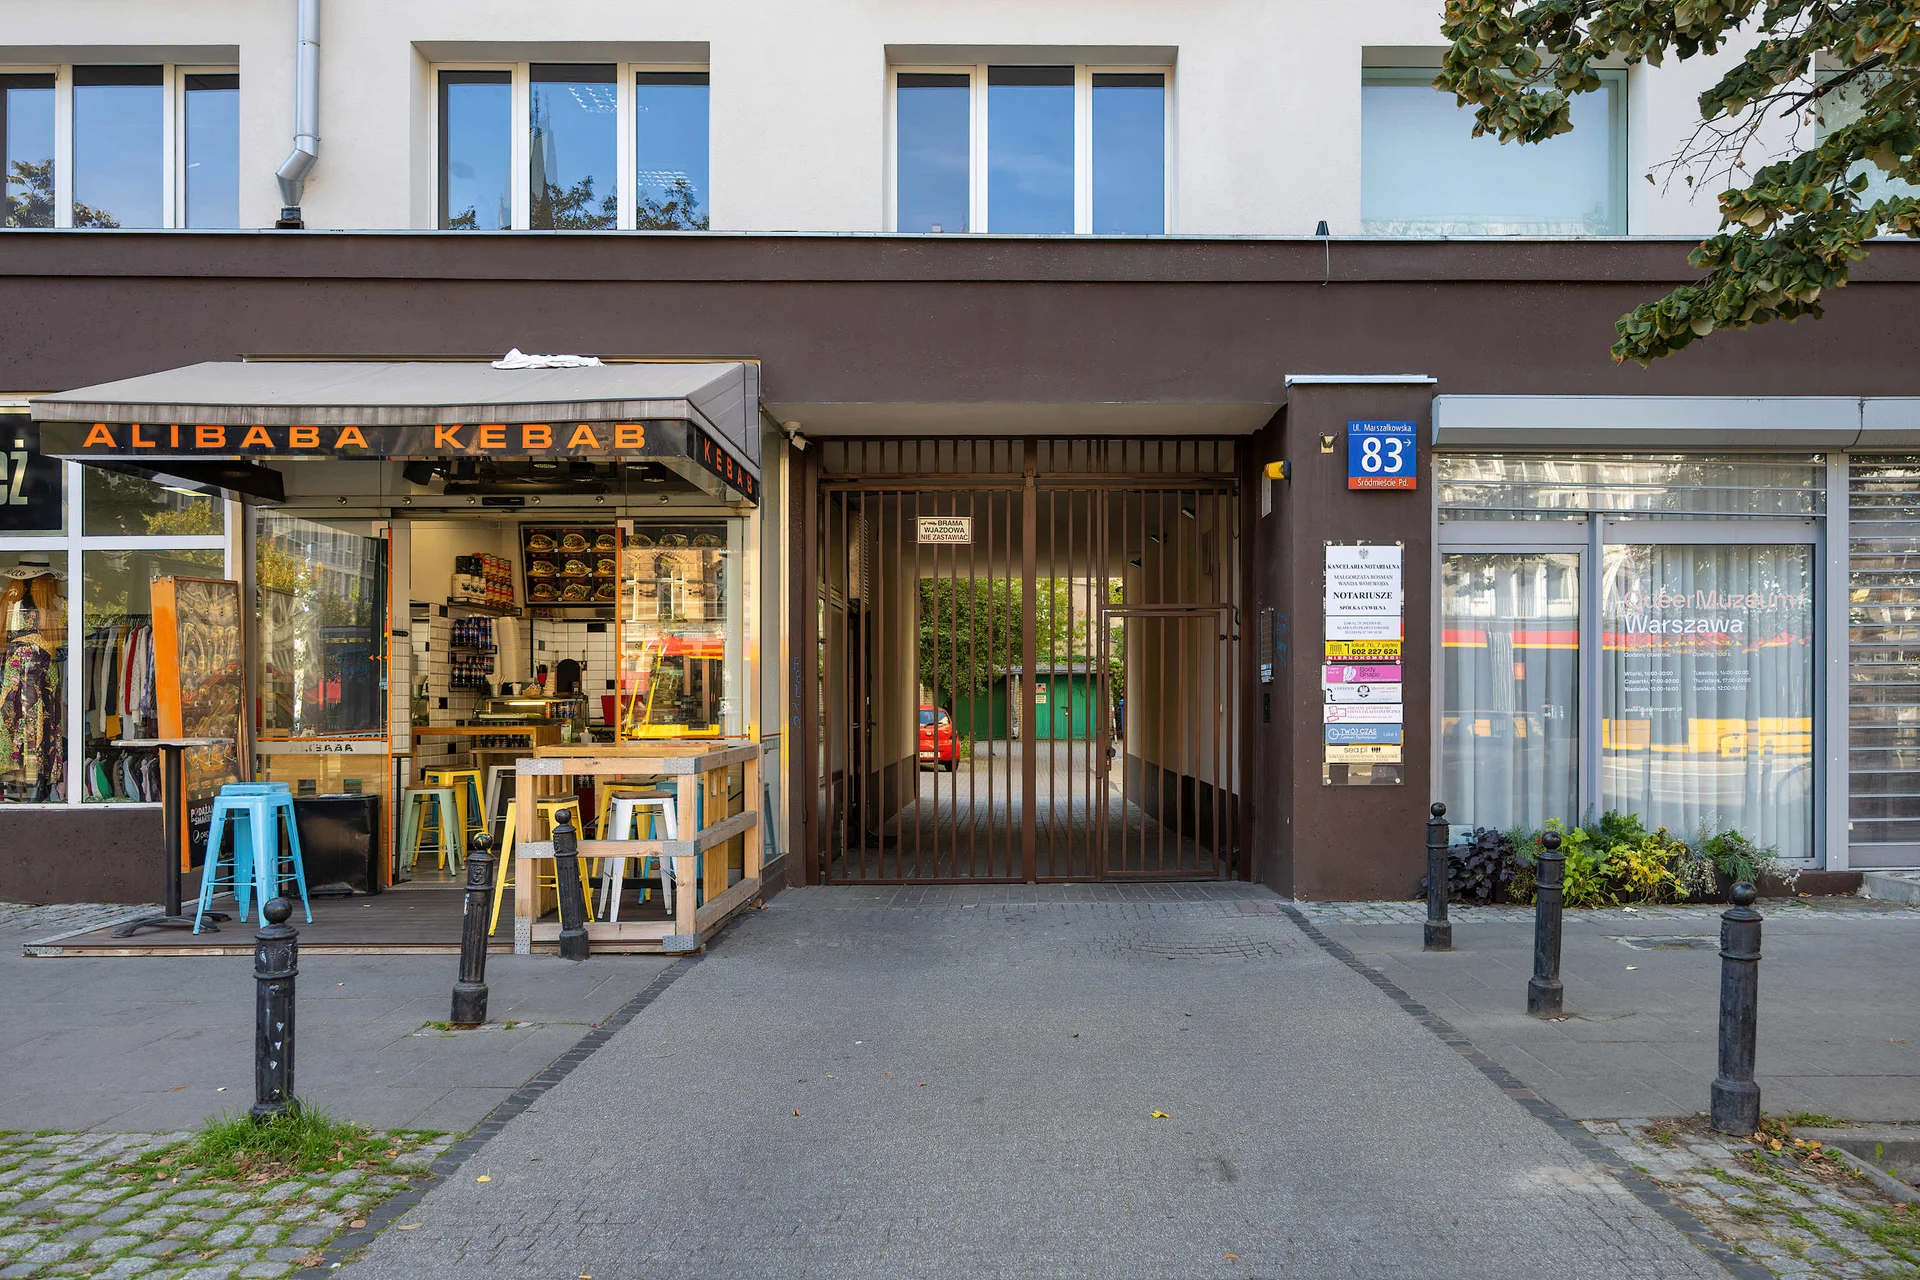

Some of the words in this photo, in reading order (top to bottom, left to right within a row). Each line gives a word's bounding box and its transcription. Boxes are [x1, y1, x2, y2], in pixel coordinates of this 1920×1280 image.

[82, 423, 369, 449] ALIBABA
[433, 423, 646, 449] KEBAB
[1363, 423, 1412, 432] Marszałkowska
[703, 437, 753, 494] KEBAB
[1361, 436, 1403, 473] 83
[1357, 477, 1396, 487] Śródmieście
[1398, 479, 1409, 487] Pd.
[1624, 614, 1744, 634] Warszawa
